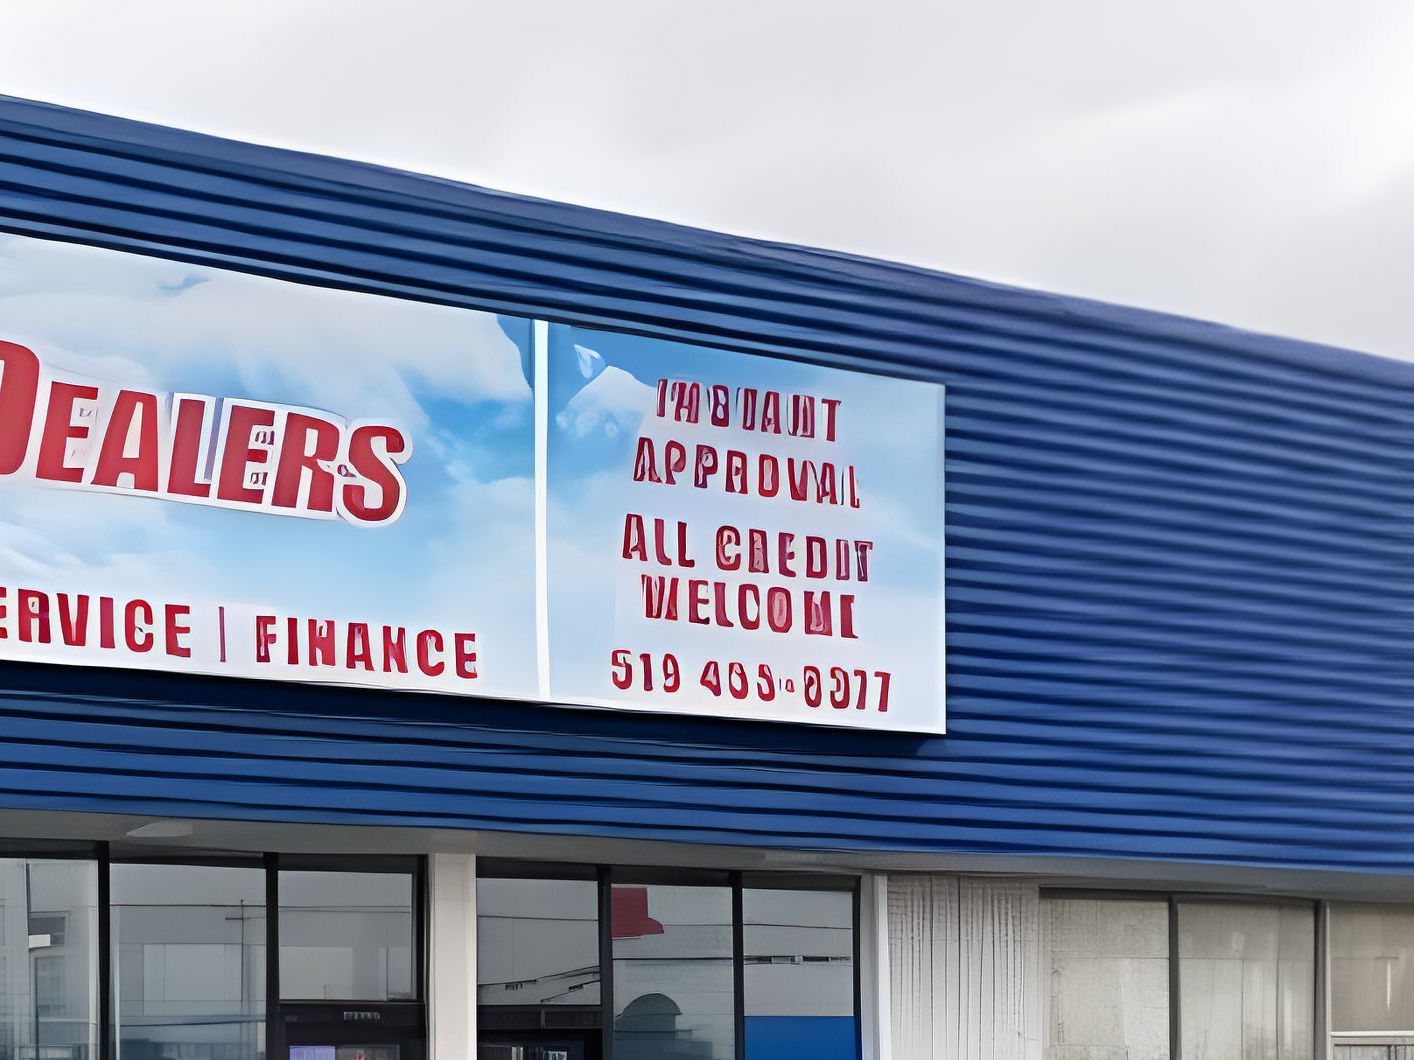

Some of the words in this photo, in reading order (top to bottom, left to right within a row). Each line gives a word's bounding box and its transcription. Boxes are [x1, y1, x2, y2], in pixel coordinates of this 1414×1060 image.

[622, 513, 695, 567] ALL
[256, 615, 478, 679] FINANCE
[611, 649, 681, 693] 519
